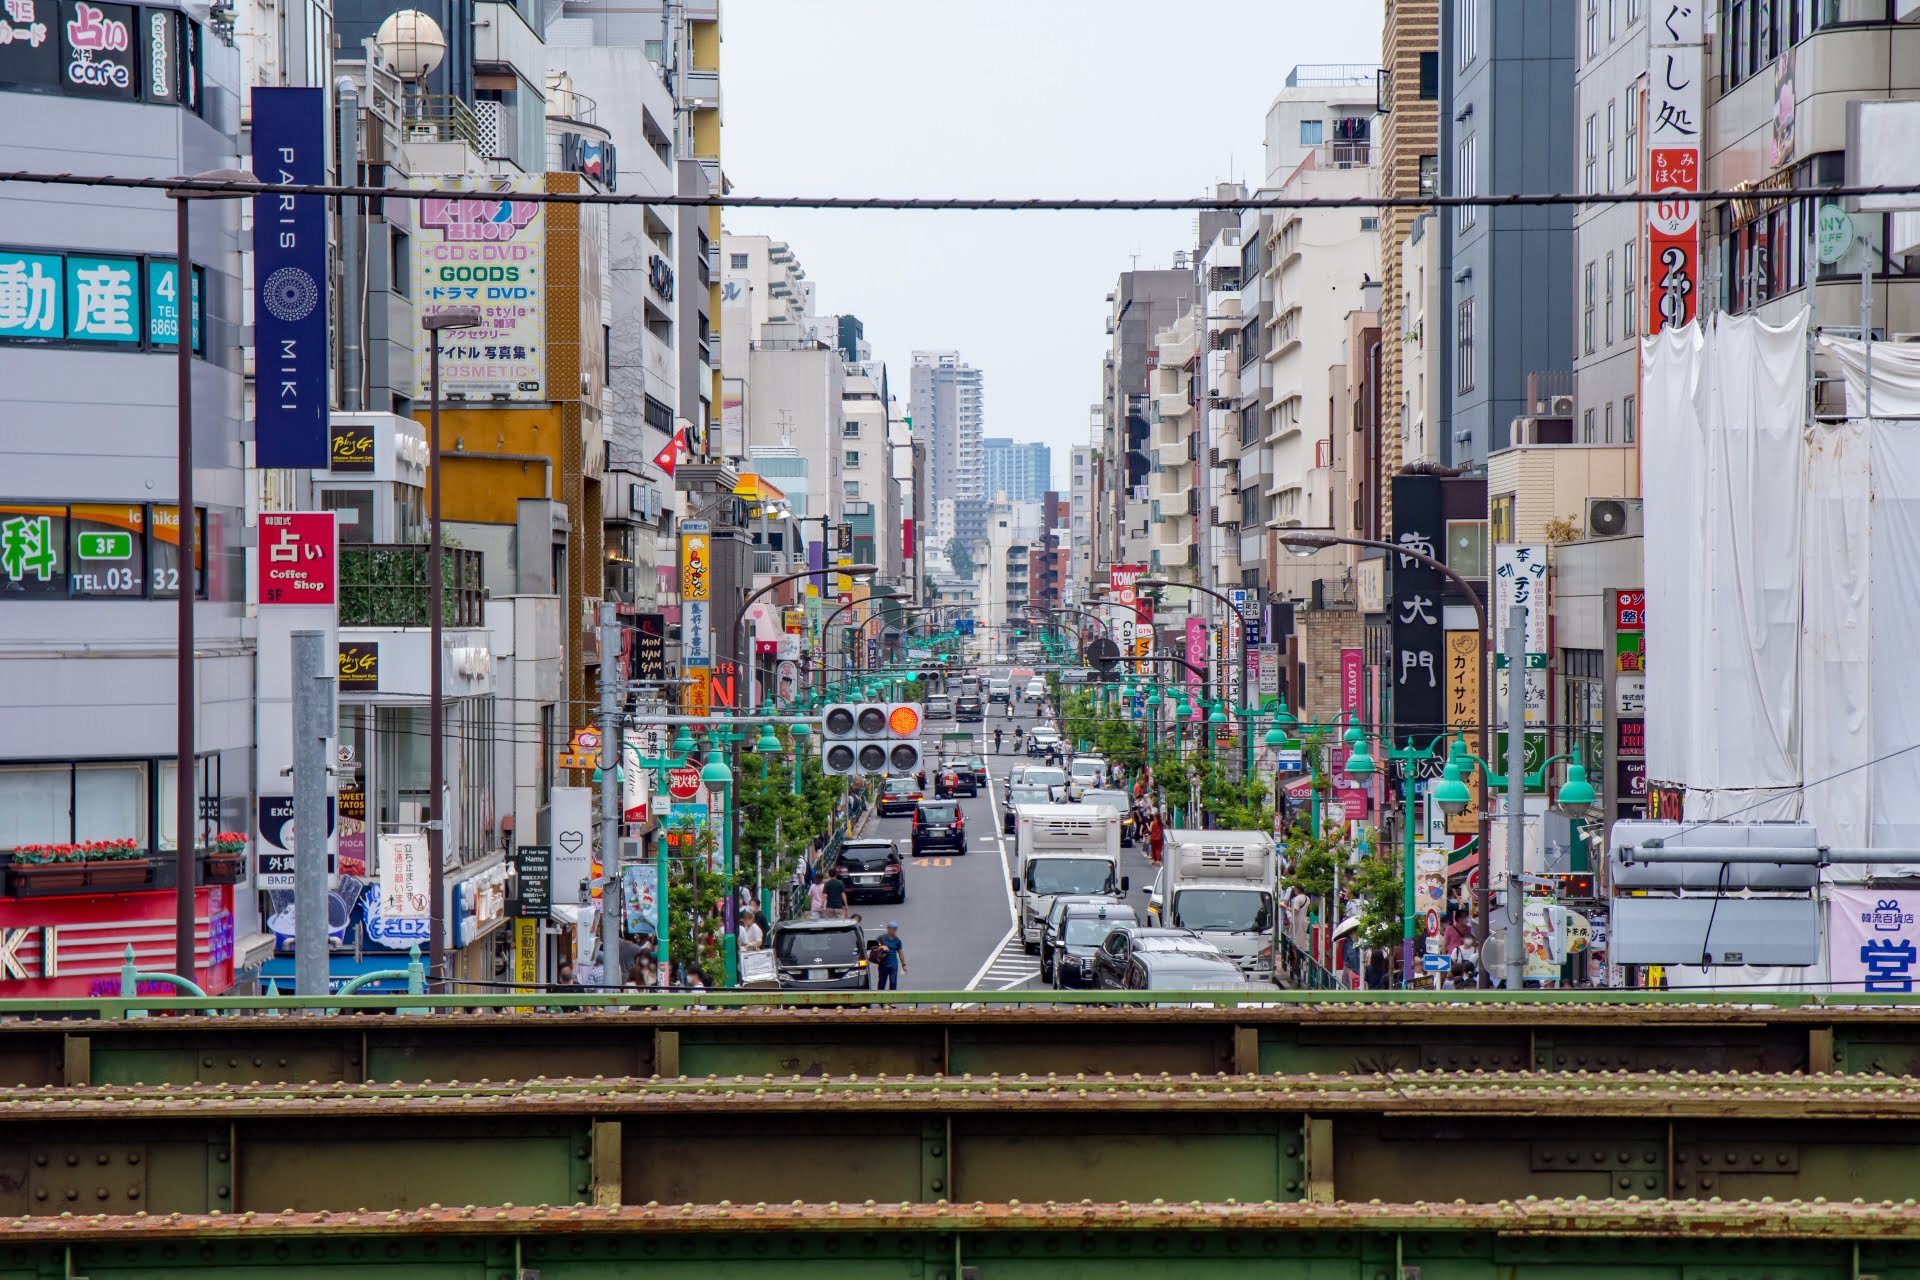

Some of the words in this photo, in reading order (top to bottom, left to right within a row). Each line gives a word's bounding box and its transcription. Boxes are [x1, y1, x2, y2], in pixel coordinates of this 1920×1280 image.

[68, 2, 128, 51] 占い
[69, 60, 128, 87] cafe
[1655, 169, 1693, 184] ほぐし
[278, 147, 295, 249] PARIS
[424, 198, 538, 225] K-POP
[447, 222, 516, 241] SHOP
[1668, 220, 1680, 231] 分
[439, 266, 520, 282] GOODS
[433, 287, 479, 300] ドラマ
[487, 287, 528, 299] DVD
[486, 305, 526, 318] style
[446, 330, 510, 340] アクセサリー
[436, 346, 480, 359] アイドル
[484, 346, 526, 359] 写真集
[281, 340, 297, 410] MIKI
[2, 516, 57, 581] 科
[95, 537, 116, 554] 3F
[270, 528, 323, 562] 占い
[269, 569, 308, 579] Coffee
[1112, 571, 1145, 586] TOMA
[293, 580, 325, 592] Shop
[267, 589, 282, 601] 5F
[1400, 531, 1438, 688] 南大門
[641, 638, 661, 646] MON
[641, 649, 661, 660] NAN
[641, 662, 662, 673] GAM
[1454, 655, 1466, 715] カイサル
[1533, 735, 1543, 744] 5F
[670, 774, 698, 788] 消火栓
[525, 855, 545, 863] Namu
[912, 857, 952, 867] 40
[1861, 912, 1914, 924] 韓流百貨店
[1861, 938, 1917, 993] 営
